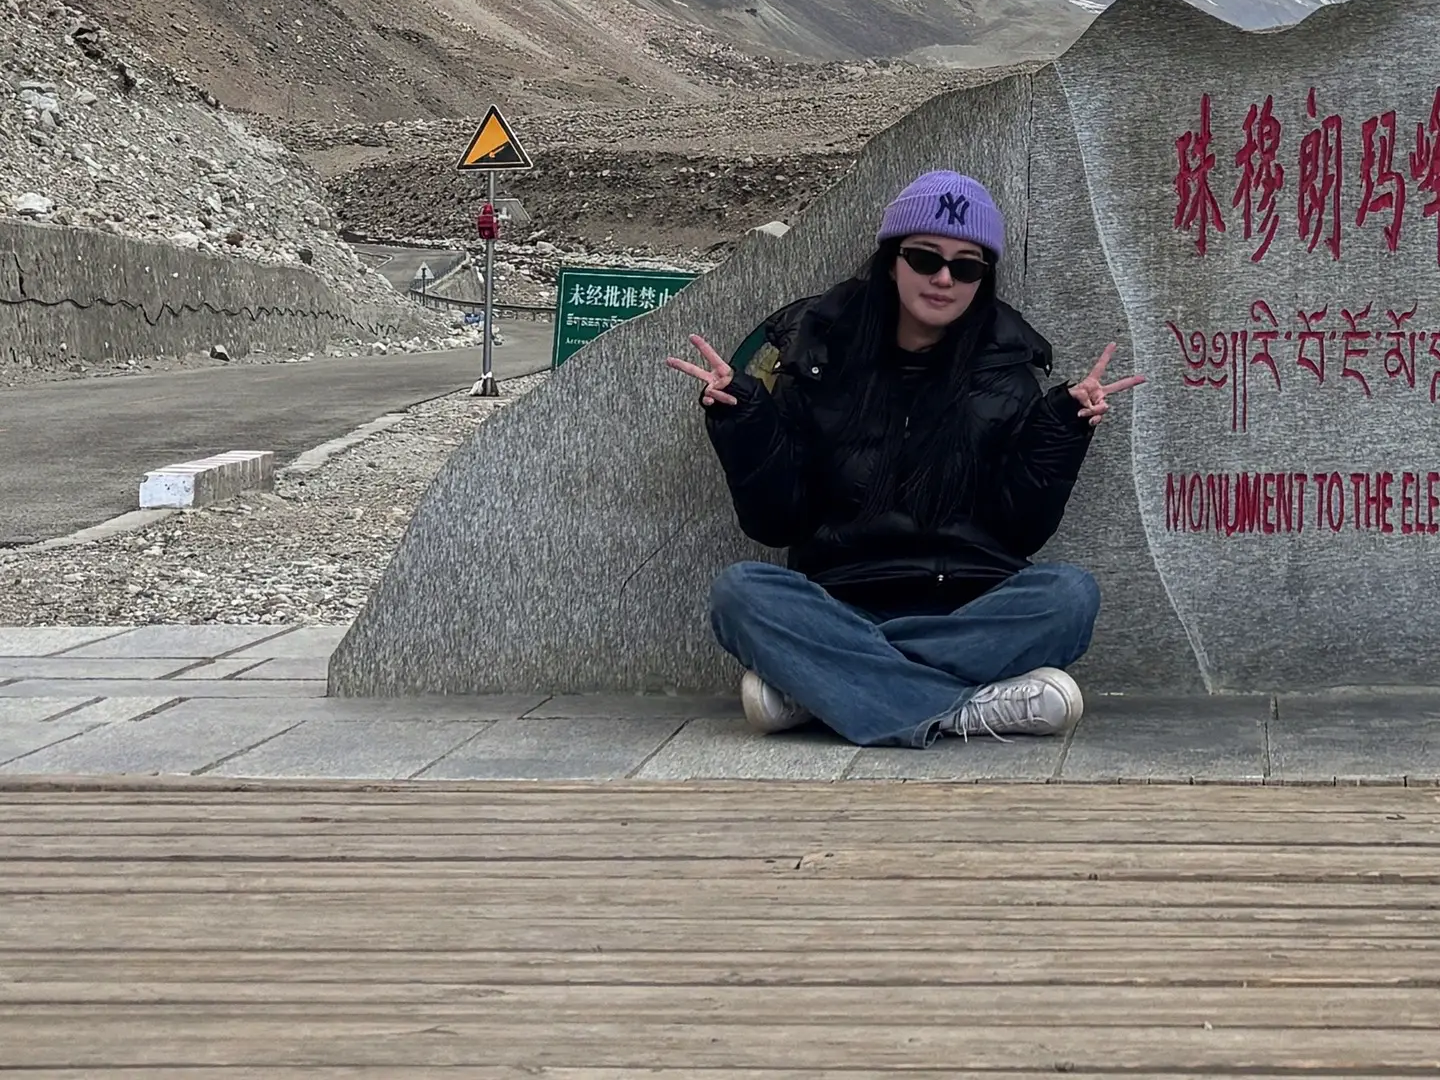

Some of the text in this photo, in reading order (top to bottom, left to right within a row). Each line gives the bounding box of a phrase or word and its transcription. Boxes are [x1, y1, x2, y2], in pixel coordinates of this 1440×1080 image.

[935, 191, 970, 226] NY
[567, 283, 684, 309] 未经批准禁止
[1165, 471, 1308, 536] MONUMENT
[1313, 471, 1345, 533] TO
[1350, 471, 1394, 534] THE
